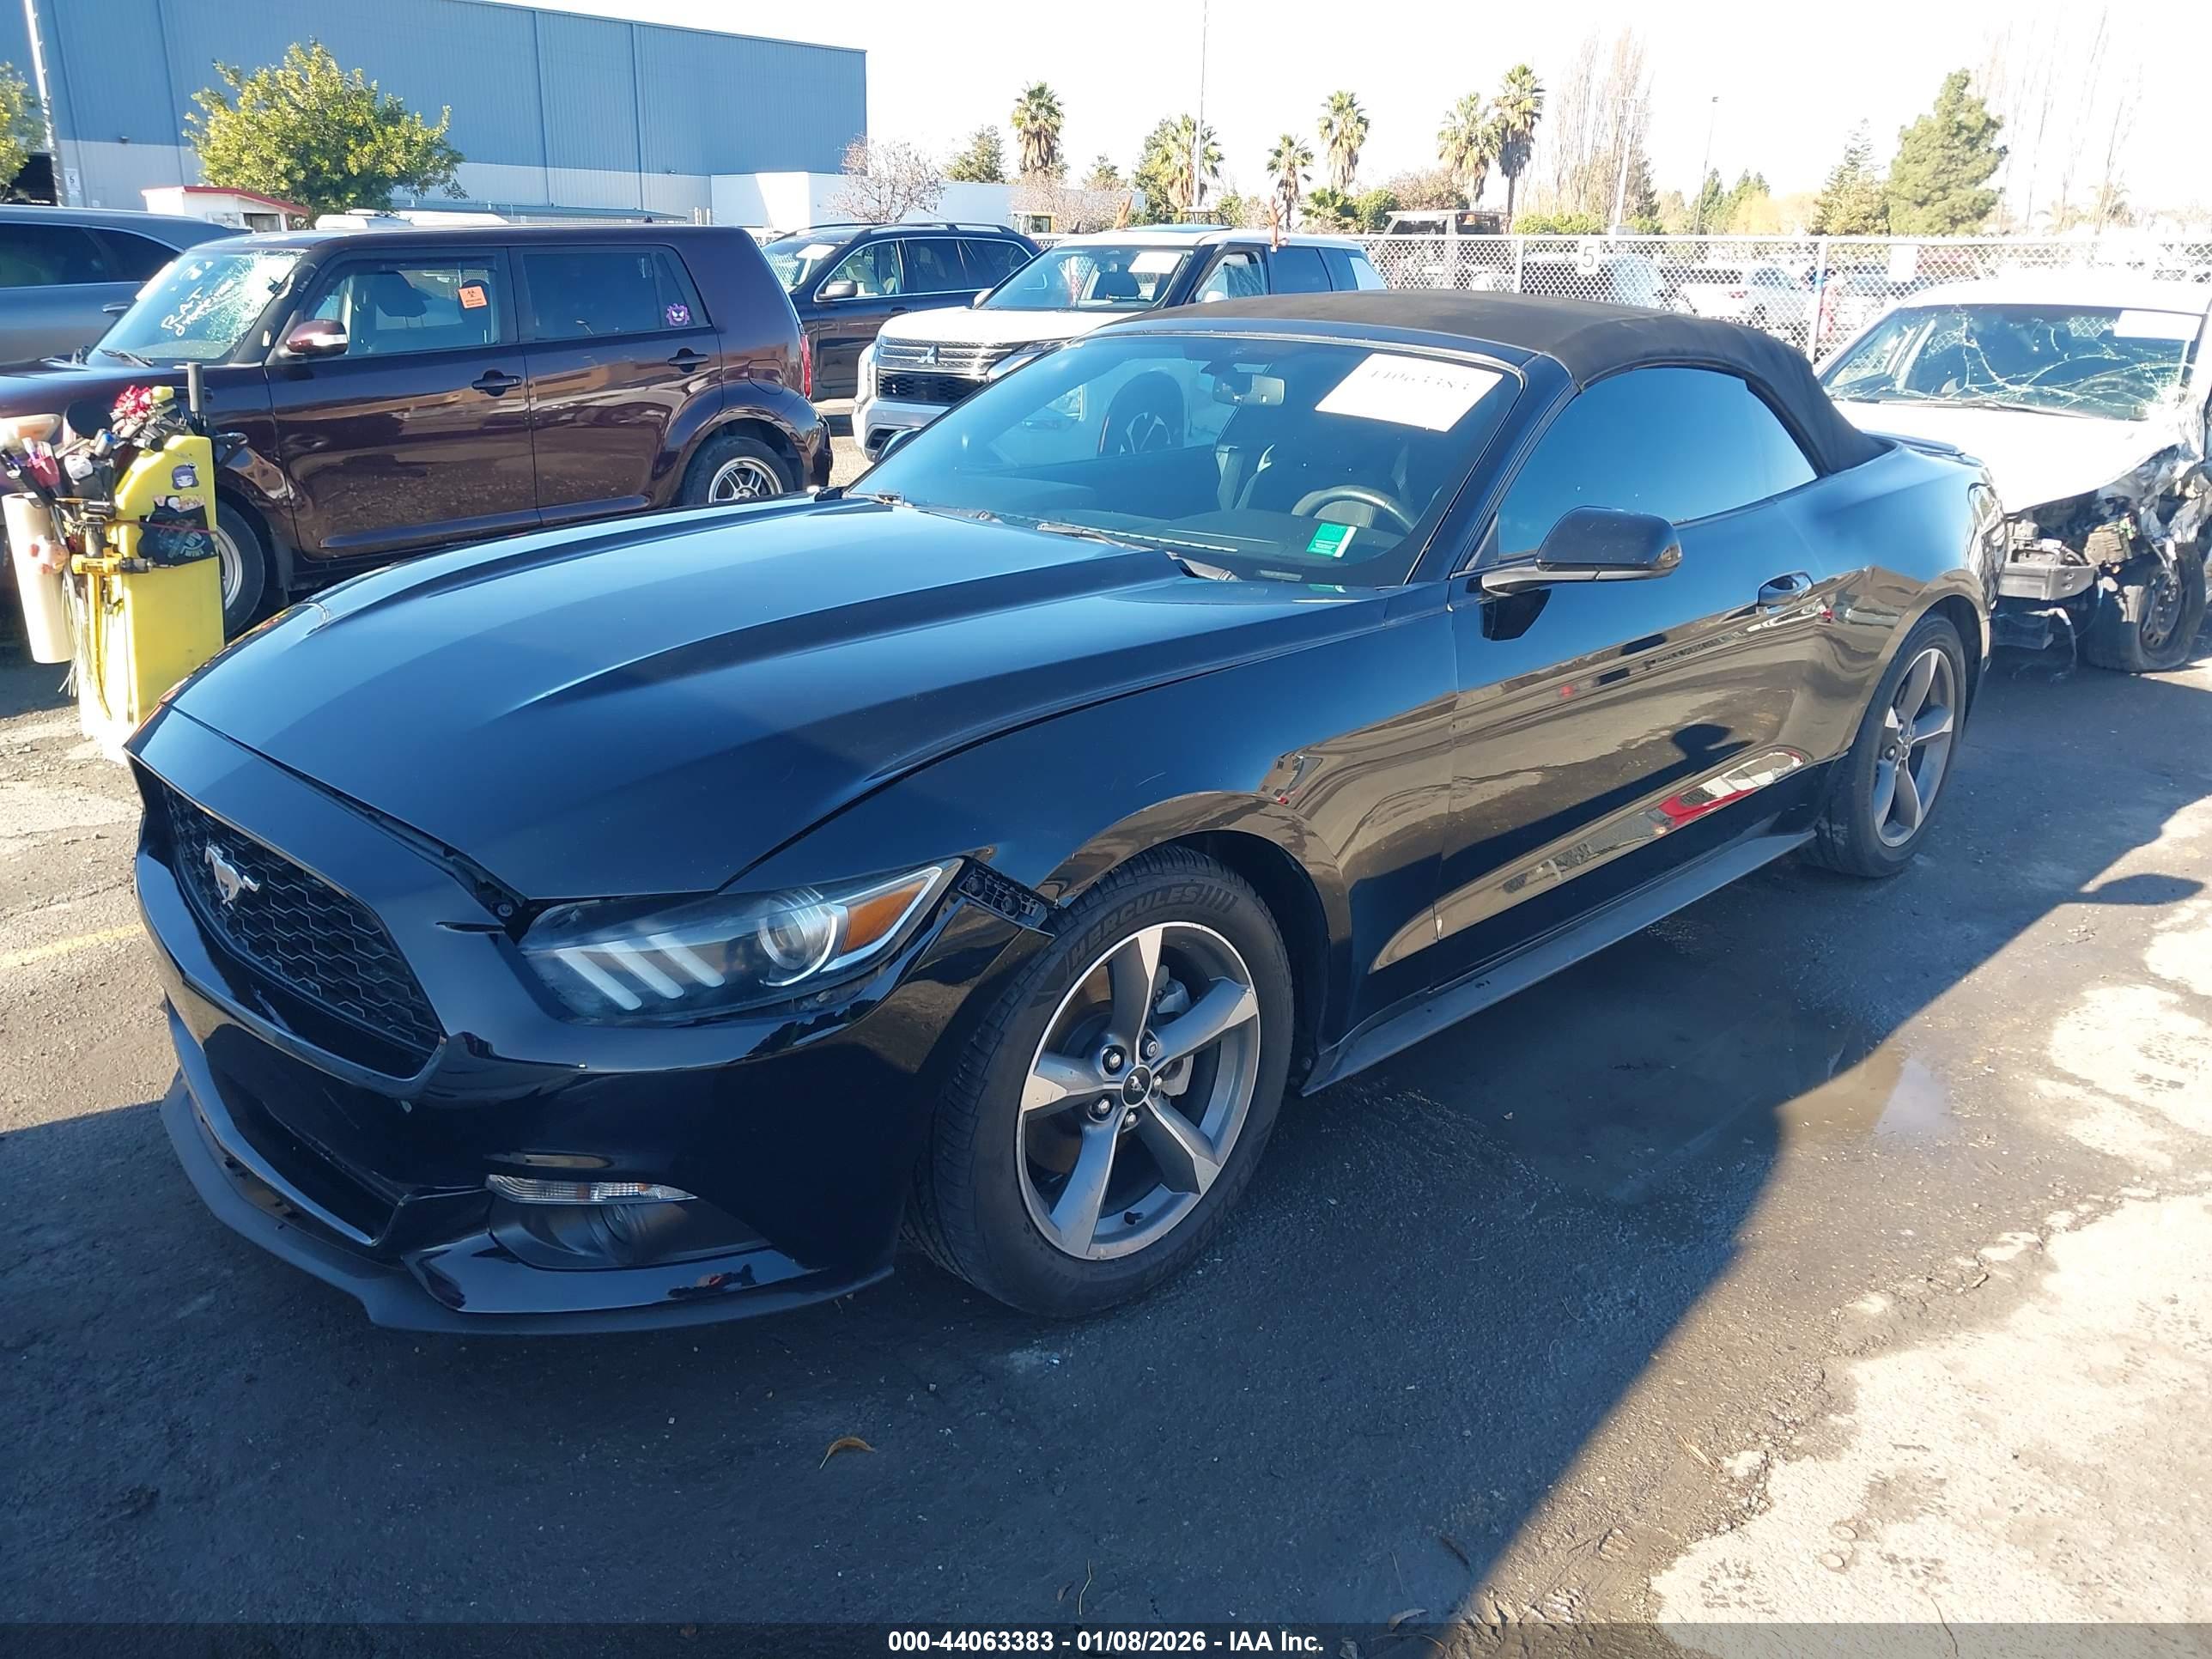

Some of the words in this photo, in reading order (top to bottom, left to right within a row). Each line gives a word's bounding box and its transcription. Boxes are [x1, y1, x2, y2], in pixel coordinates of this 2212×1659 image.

[1582, 246, 1595, 268] 5
[161, 286, 204, 330] RAT
[1071, 885, 1199, 963] HERCULES
